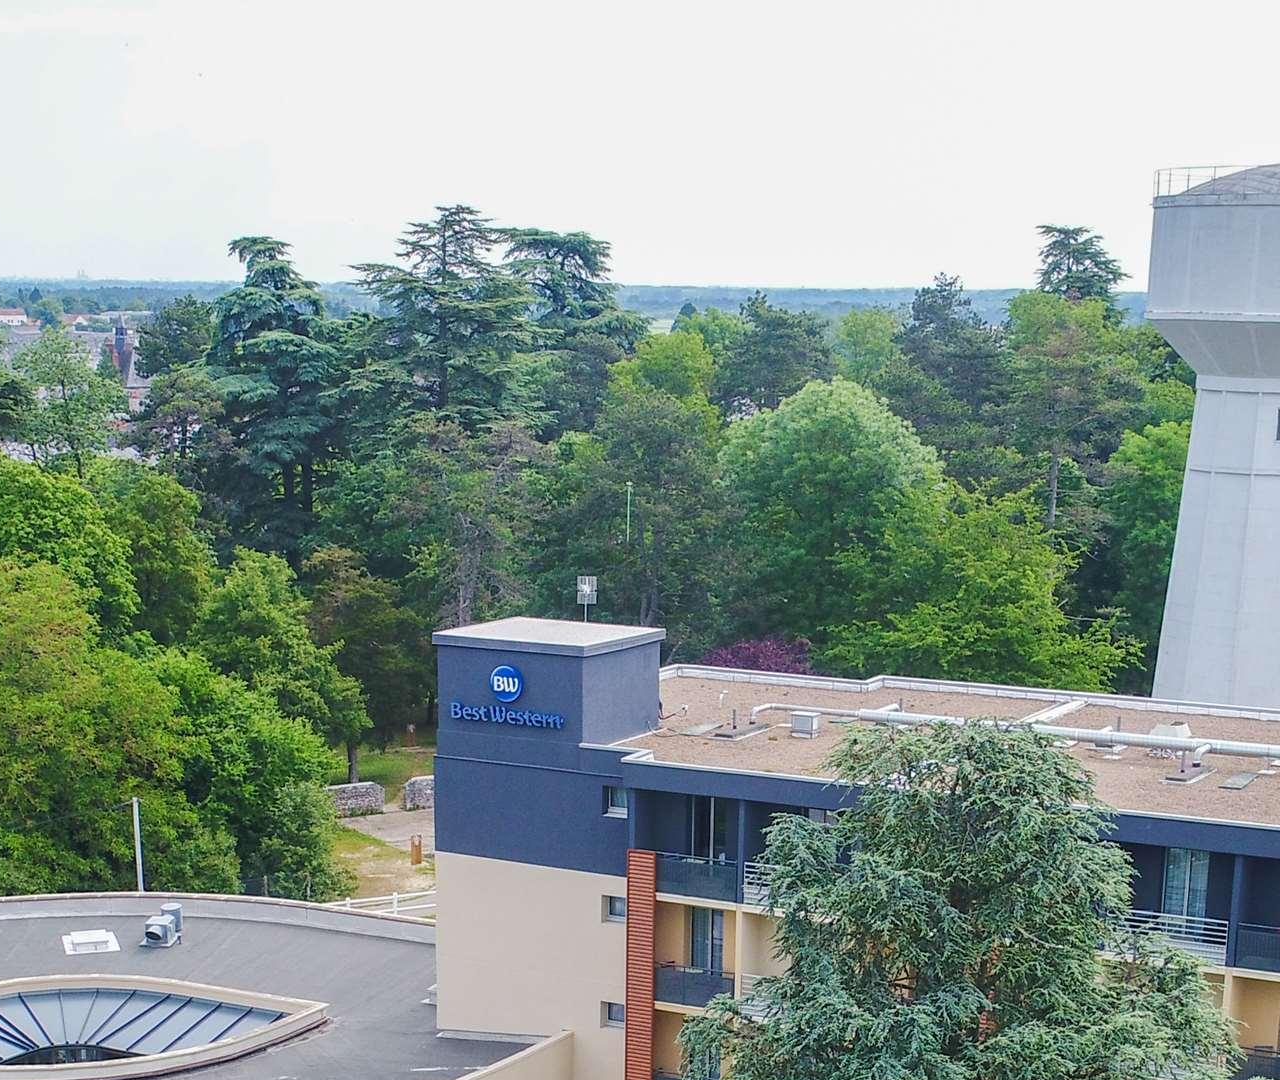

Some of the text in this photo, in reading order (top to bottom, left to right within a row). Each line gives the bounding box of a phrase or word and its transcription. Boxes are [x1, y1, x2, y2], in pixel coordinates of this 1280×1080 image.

[493, 675, 519, 693] BW
[450, 702, 562, 728] Best Western
